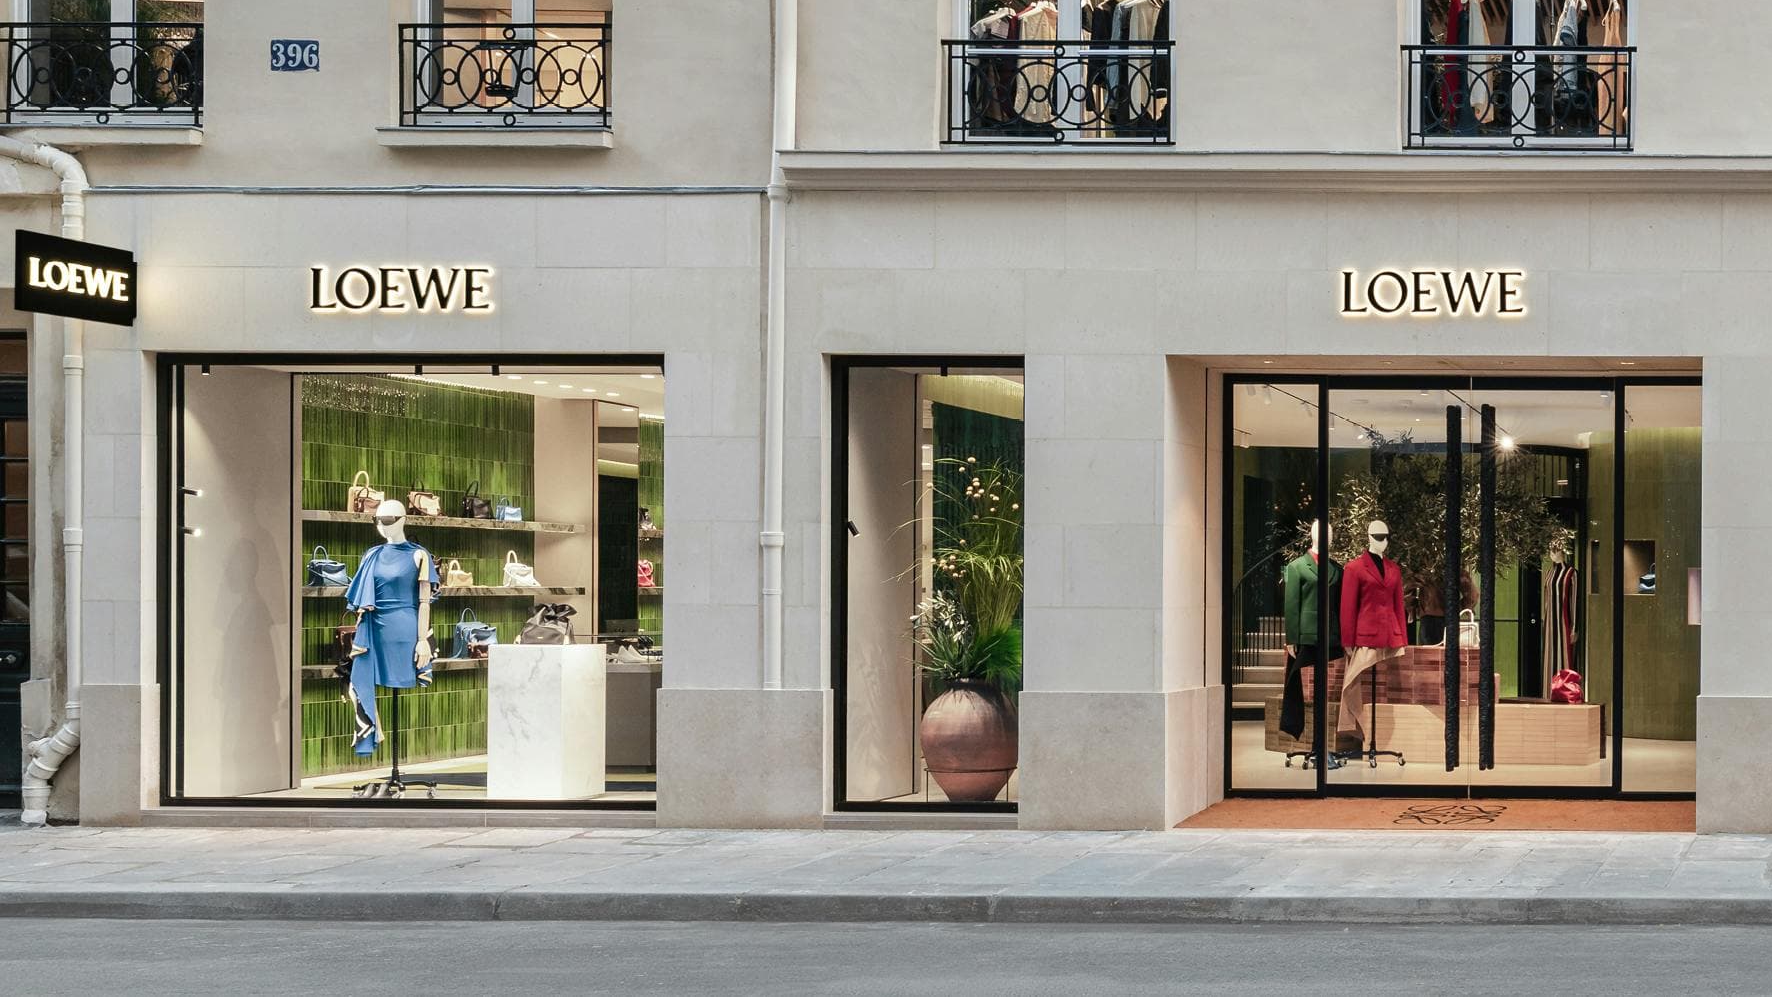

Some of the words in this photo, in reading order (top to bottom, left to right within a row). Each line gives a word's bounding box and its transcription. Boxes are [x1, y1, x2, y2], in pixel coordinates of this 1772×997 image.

[272, 43, 318, 67] 396
[29, 257, 129, 302] LOEWE
[310, 267, 490, 310] LOEWE
[1341, 271, 1524, 314] LOEWE
